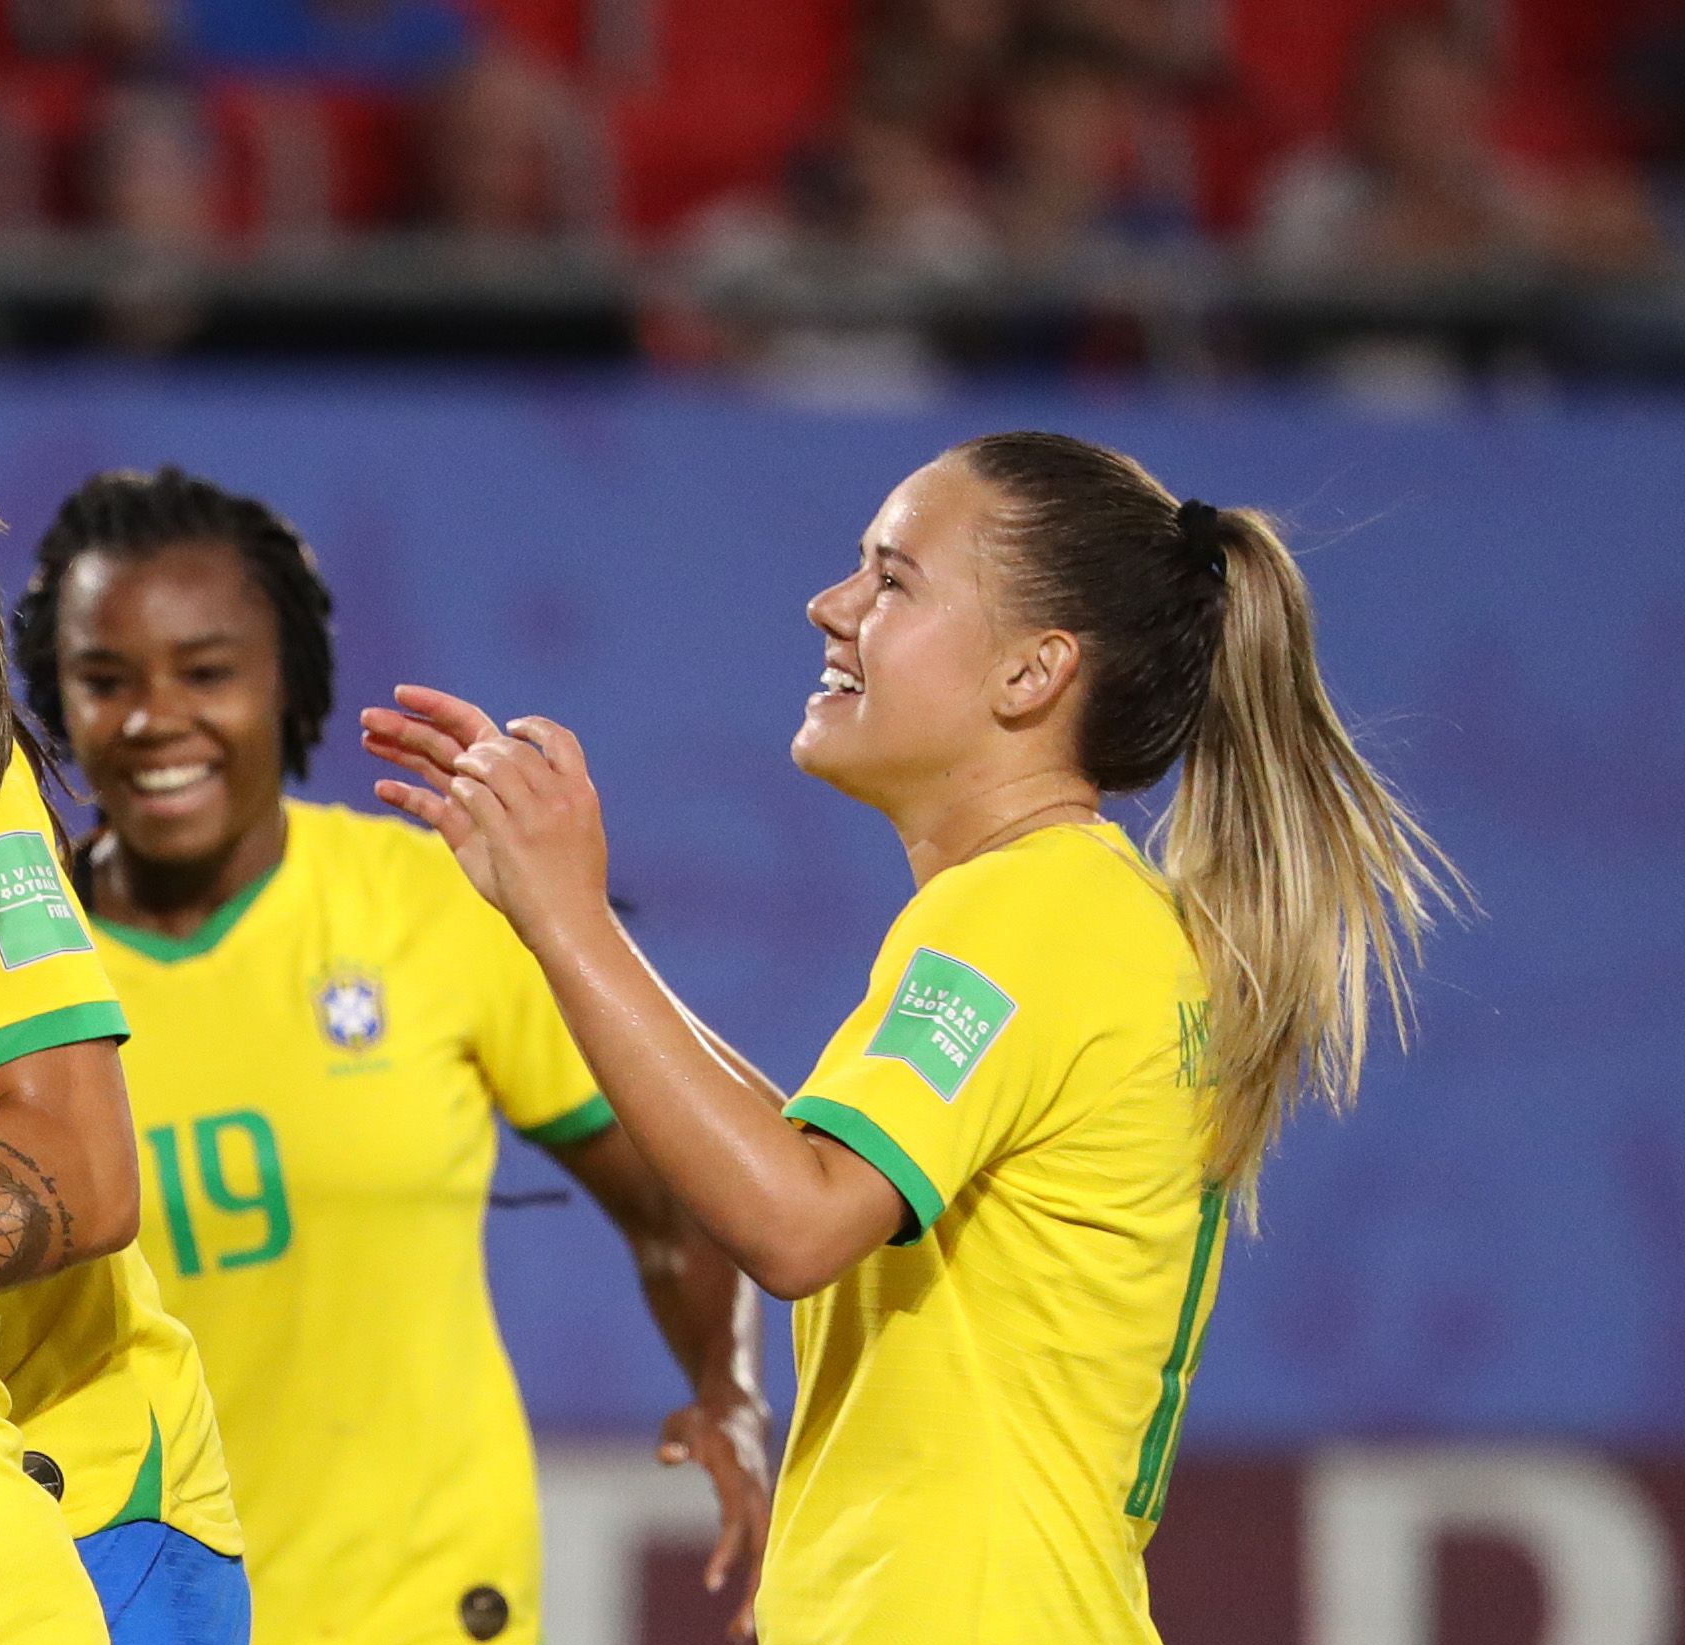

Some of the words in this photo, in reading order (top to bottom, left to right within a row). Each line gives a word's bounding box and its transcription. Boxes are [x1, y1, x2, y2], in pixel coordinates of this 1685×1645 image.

[46, 903, 73, 919] FIFA
[902, 993, 980, 1046] FOOTBALL
[908, 980, 990, 1035] LIVING
[931, 1030, 968, 1069] FIFA
[146, 1105, 293, 1278] 19
